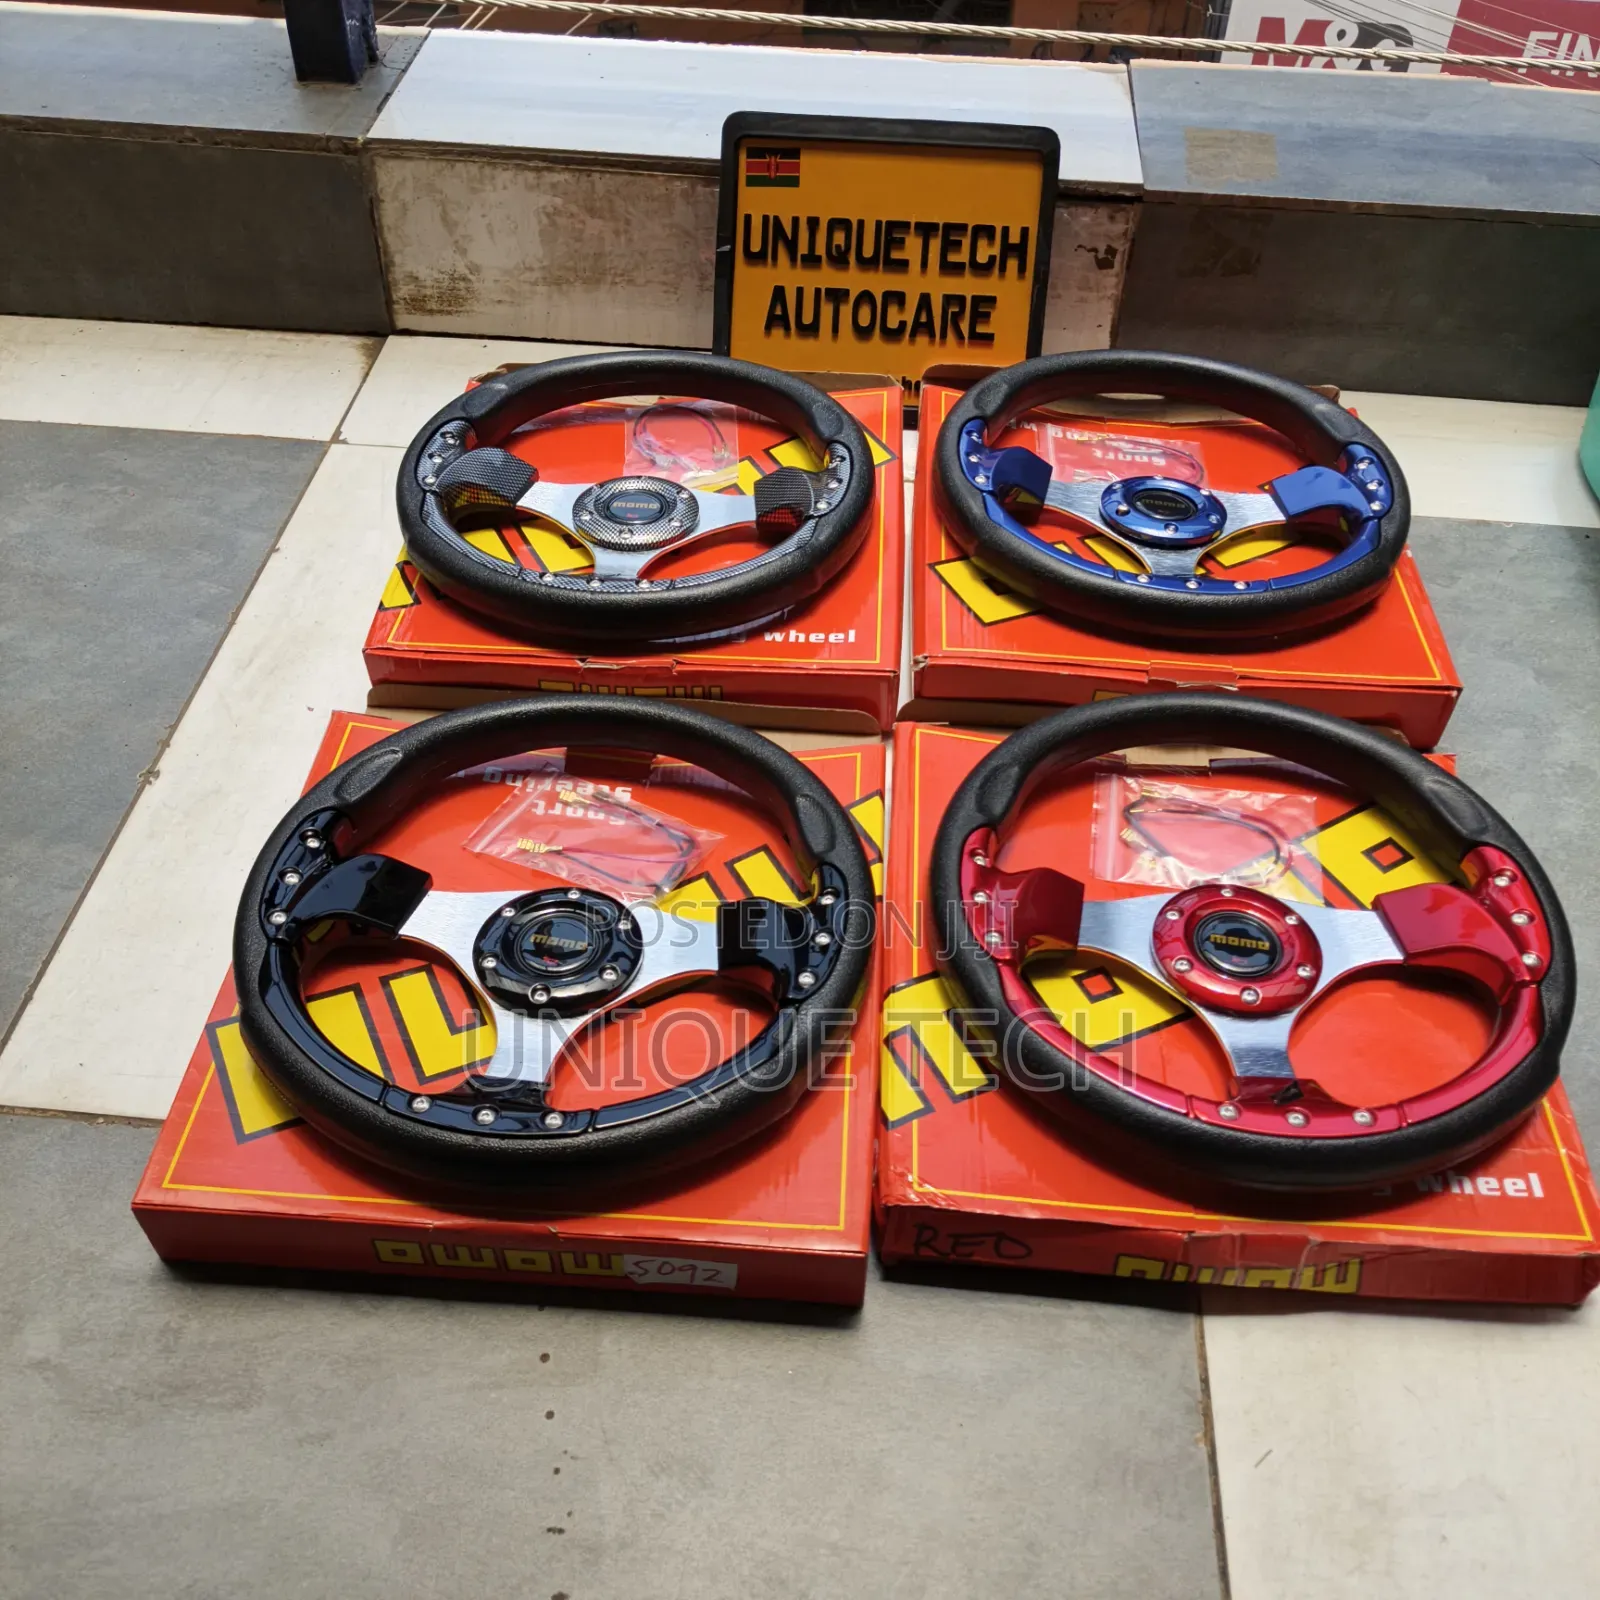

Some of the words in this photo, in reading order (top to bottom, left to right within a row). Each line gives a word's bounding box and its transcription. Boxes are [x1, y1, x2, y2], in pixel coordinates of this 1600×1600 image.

[742, 213, 1030, 276] UNIQUETECH
[763, 284, 998, 343] AUTOCARE
[612, 501, 658, 510] momo
[763, 629, 856, 643] wheel
[1209, 933, 1271, 952] momo
[1415, 1172, 1545, 1198] wheel
[912, 1223, 1033, 1260] RED
